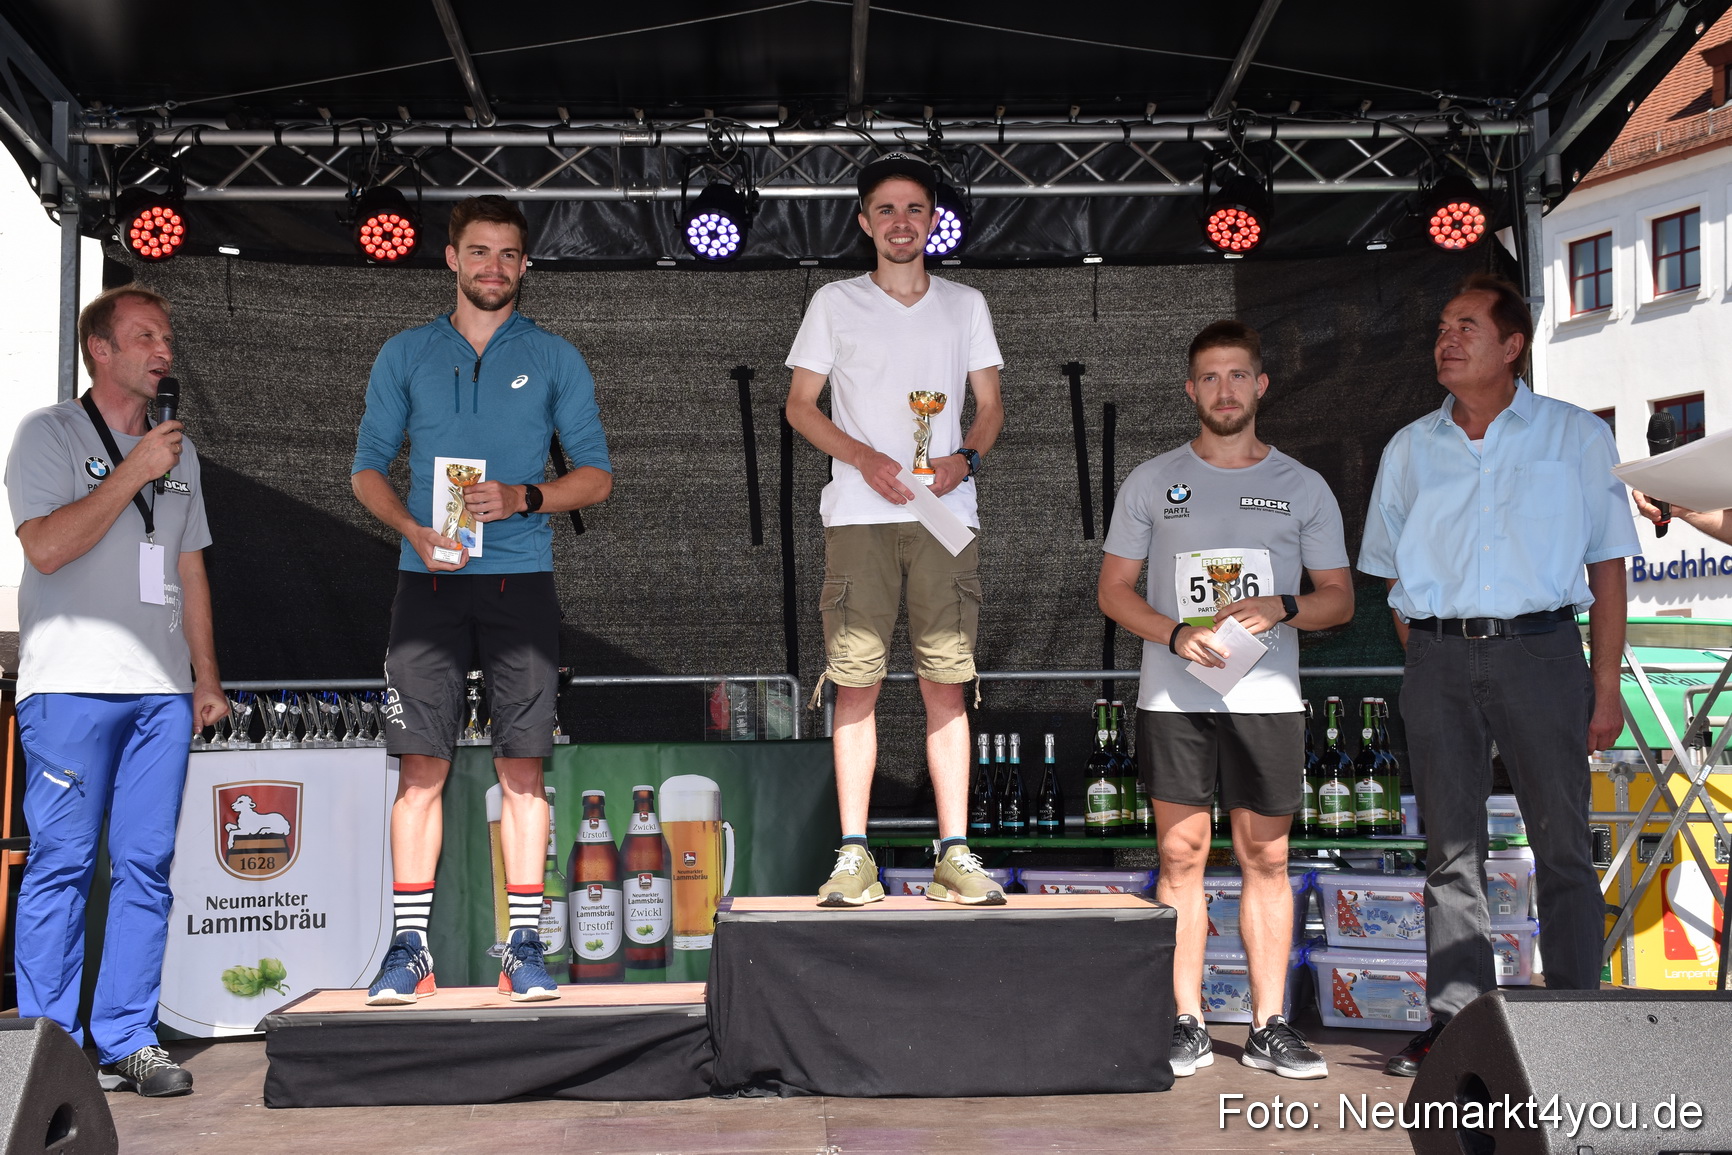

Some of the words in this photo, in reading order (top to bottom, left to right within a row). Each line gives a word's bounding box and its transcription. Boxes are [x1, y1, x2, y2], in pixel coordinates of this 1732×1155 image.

[1241, 497, 1290, 512] BOCK
[582, 831, 608, 839] Urstoff
[240, 857, 275, 870] 1628
[206, 891, 308, 910] Neumarkter
[576, 910, 615, 918] Lammsbräu
[630, 908, 662, 917] Zwickl
[187, 909, 326, 935] Lammsbräu
[578, 921, 614, 931] Urstoff
